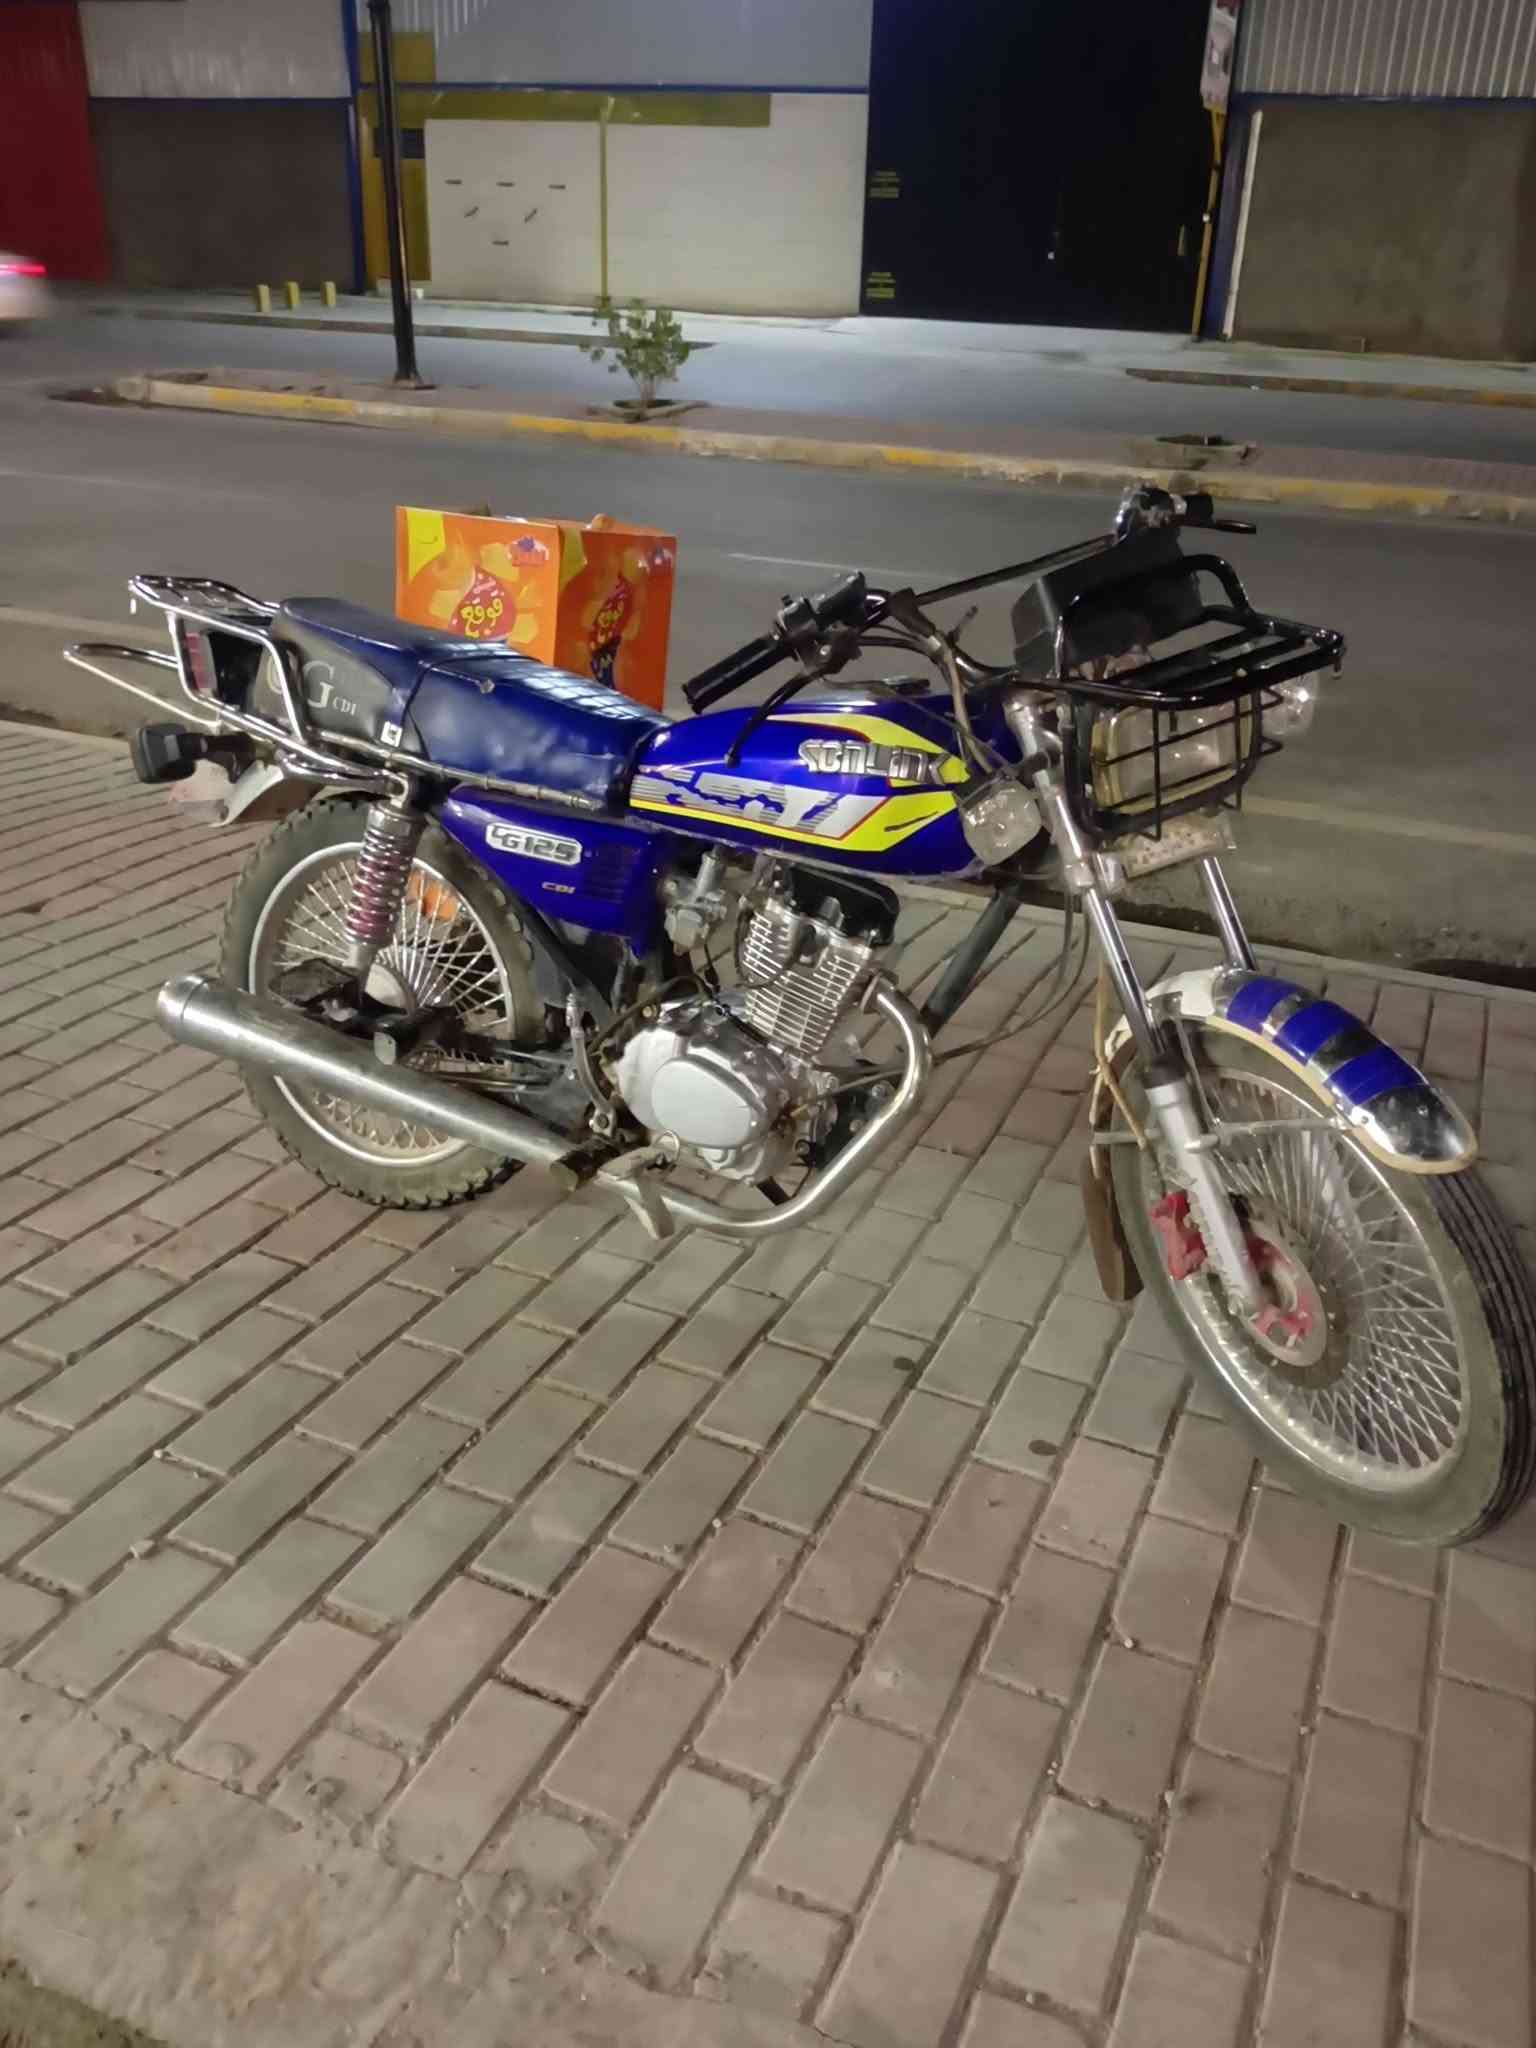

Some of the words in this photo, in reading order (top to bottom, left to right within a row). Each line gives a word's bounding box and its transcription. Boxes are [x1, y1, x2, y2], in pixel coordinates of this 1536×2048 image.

[332, 696, 357, 716] CDI
[491, 825, 577, 861] CG125
[541, 881, 576, 895] CDI
